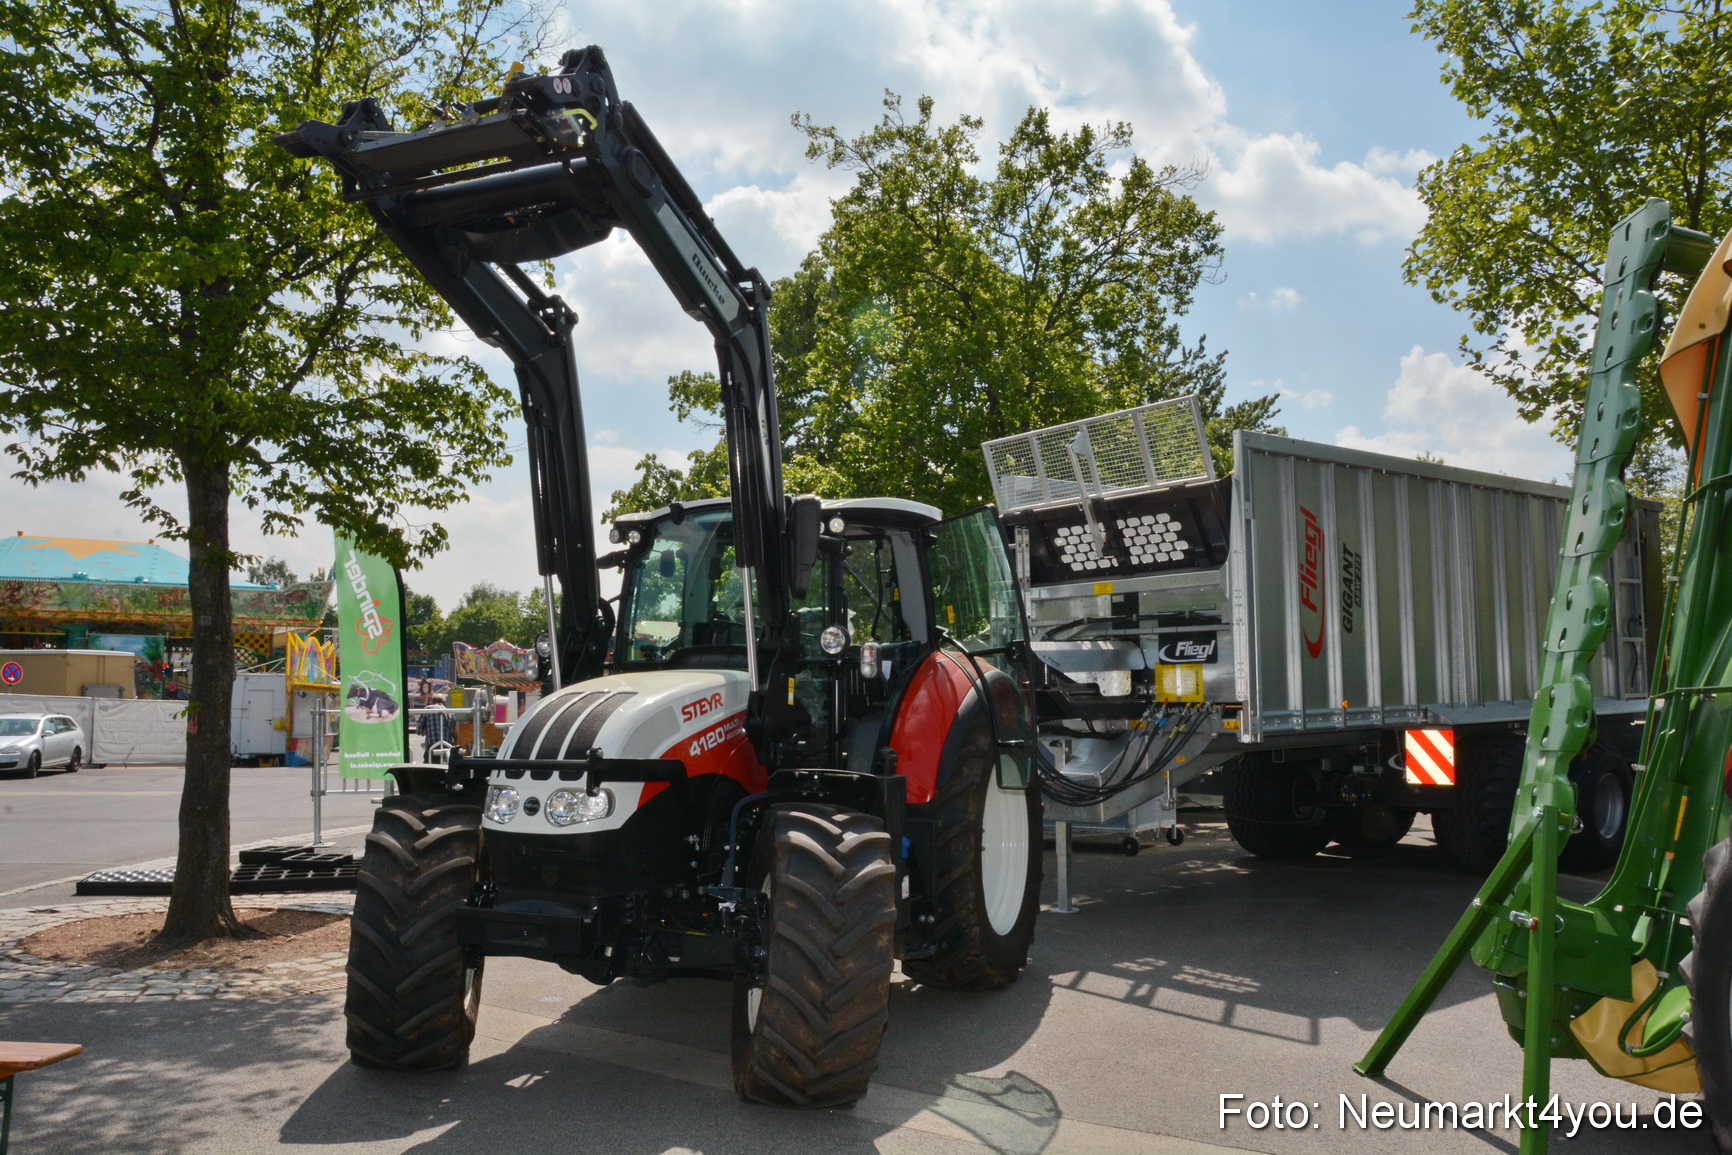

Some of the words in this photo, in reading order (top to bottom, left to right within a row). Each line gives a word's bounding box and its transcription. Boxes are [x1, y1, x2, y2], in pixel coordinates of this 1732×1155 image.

[1299, 505, 1324, 614] Fliegl
[1342, 542, 1354, 634] GIGANT
[1175, 640, 1216, 659] Fliegl
[681, 692, 724, 724] STEYR
[689, 727, 726, 757] 4120
